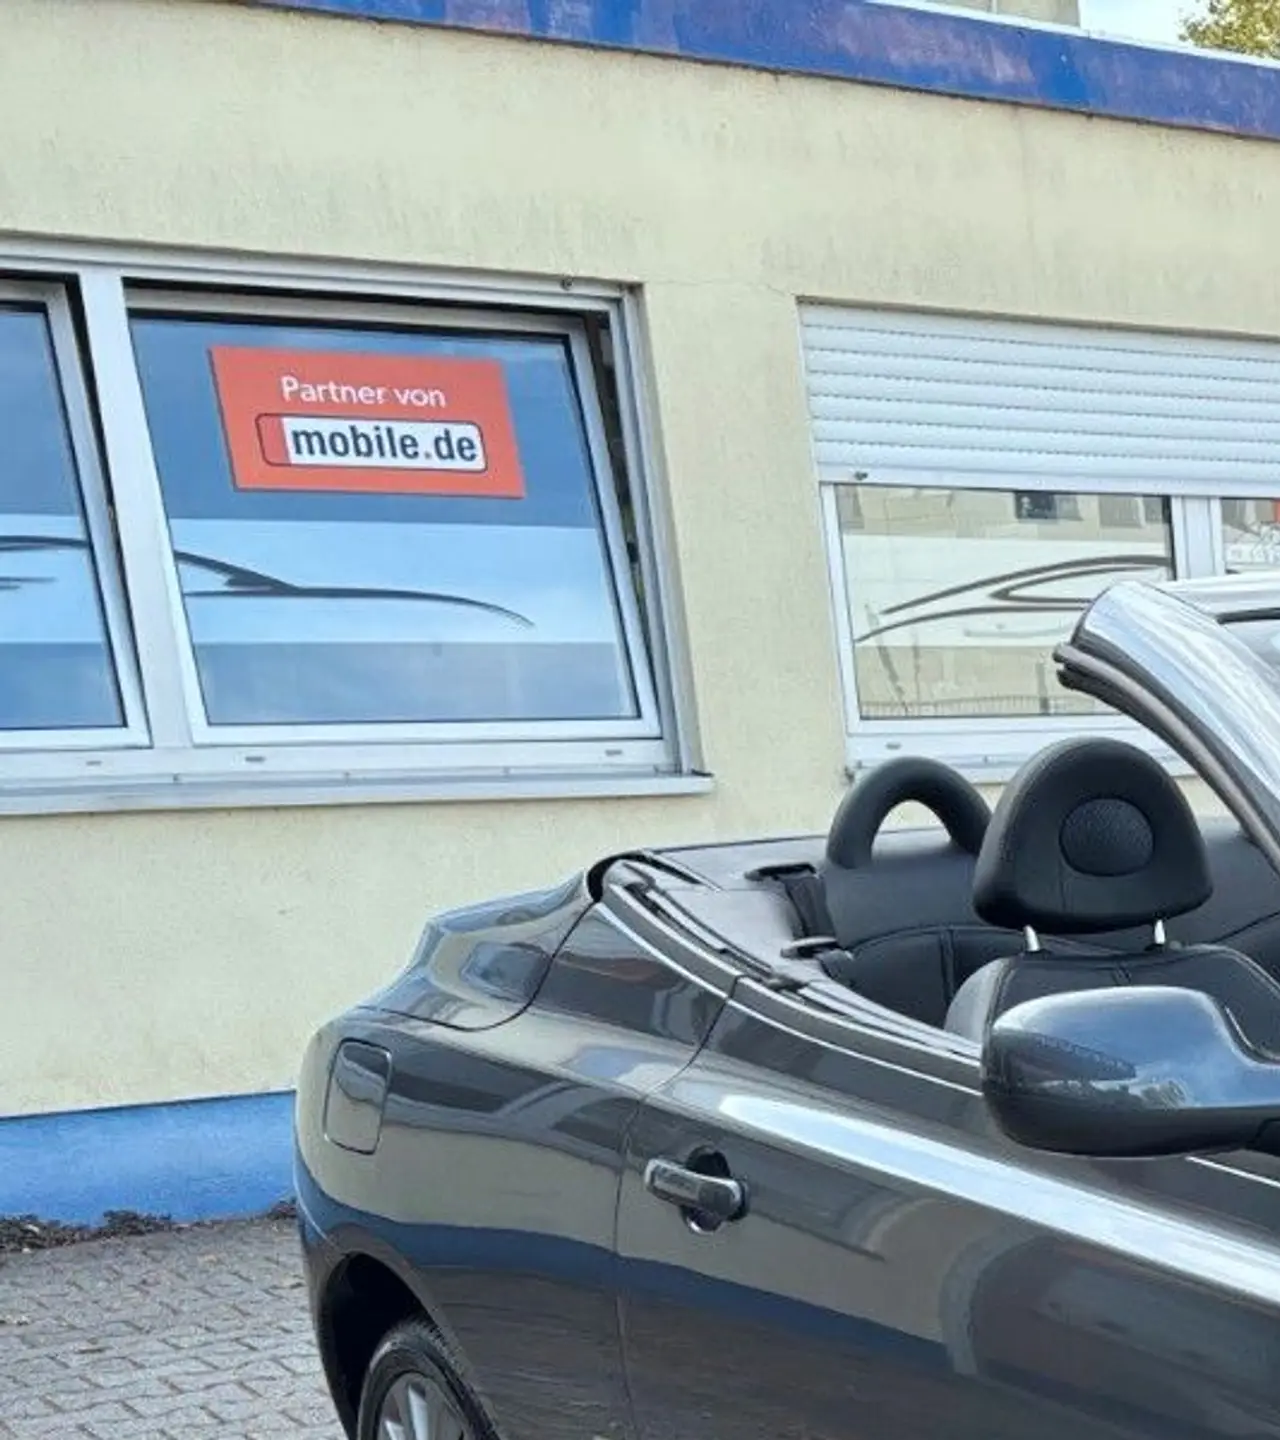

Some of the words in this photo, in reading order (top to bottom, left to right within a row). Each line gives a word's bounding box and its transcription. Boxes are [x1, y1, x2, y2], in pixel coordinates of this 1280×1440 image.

[281, 375, 387, 406] Partner
[395, 386, 447, 408] von
[292, 426, 478, 462] mobile.de
